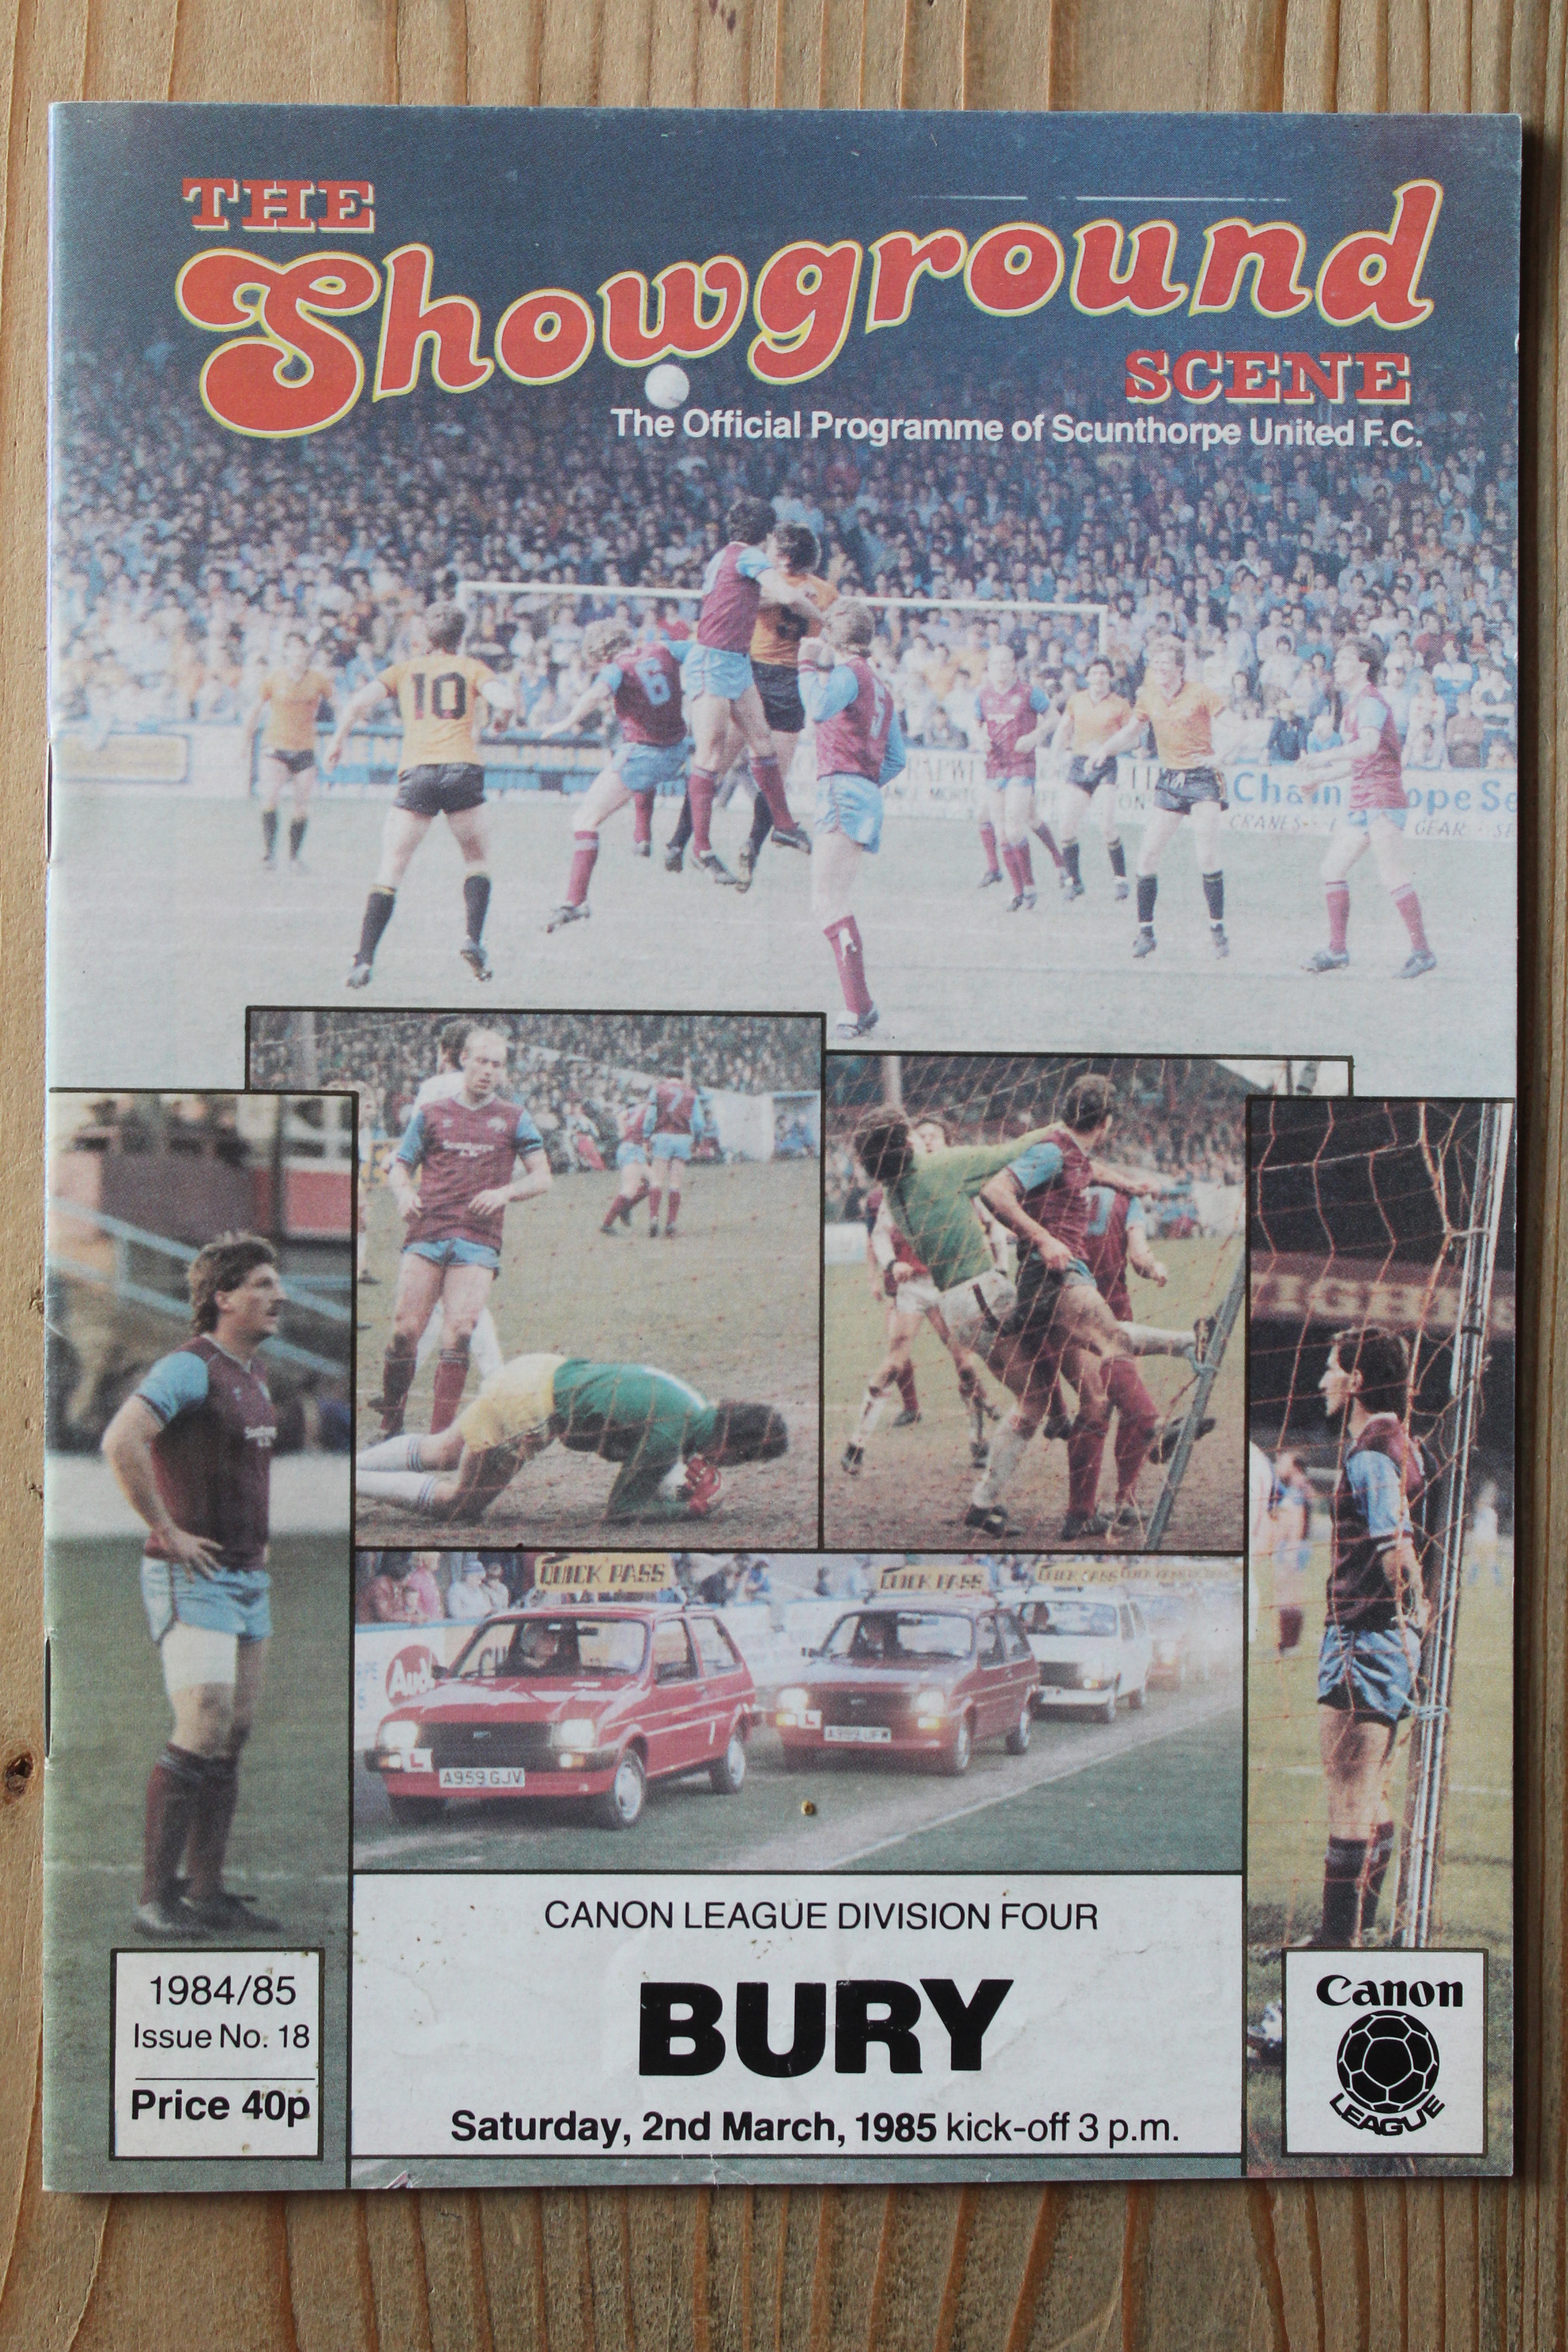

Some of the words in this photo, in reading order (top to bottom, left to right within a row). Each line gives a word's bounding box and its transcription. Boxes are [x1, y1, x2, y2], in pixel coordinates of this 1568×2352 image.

[183, 178, 375, 233] THE
[176, 178, 1443, 439] Showground
[1126, 349, 1411, 404] SCENE
[611, 408, 675, 439] The
[683, 408, 801, 439] Official
[811, 412, 1000, 447] Programme
[1012, 414, 1045, 442] of
[1053, 414, 1241, 451] Scunthorpe
[1250, 418, 1355, 446] United
[1364, 420, 1423, 447] F.C.
[411, 672, 467, 721] 10
[634, 656, 671, 706] 6
[540, 1564, 602, 1585] QUICK
[608, 1563, 665, 1584] PASS
[410, 1753, 423, 1768] L
[443, 1770, 485, 1786] A959
[489, 1770, 523, 1786] GJV
[546, 1901, 674, 1929] CANON
[685, 1902, 828, 1930] LEAGUE
[839, 1903, 990, 1931] DIVISION
[1002, 1903, 1098, 1931] FOUR
[150, 1975, 297, 2006] 1984/85
[1316, 1974, 1464, 2008] Canon
[135, 2023, 213, 2049] Issue
[220, 2023, 268, 2049] No.
[278, 2024, 310, 2049] 18
[639, 1979, 1015, 2079] BURY
[131, 2089, 231, 2121] Price
[242, 2090, 311, 2128] 40p
[1329, 2093, 1446, 2136] LEAGUE
[451, 2110, 632, 2149] Saturday,
[642, 2112, 711, 2142] 2nd
[723, 2112, 846, 2149] March,
[856, 2112, 938, 2143] 1985
[948, 2112, 1071, 2143] kick-off
[1079, 2113, 1099, 2143] 3
[1110, 2119, 1179, 2149] p.m.
